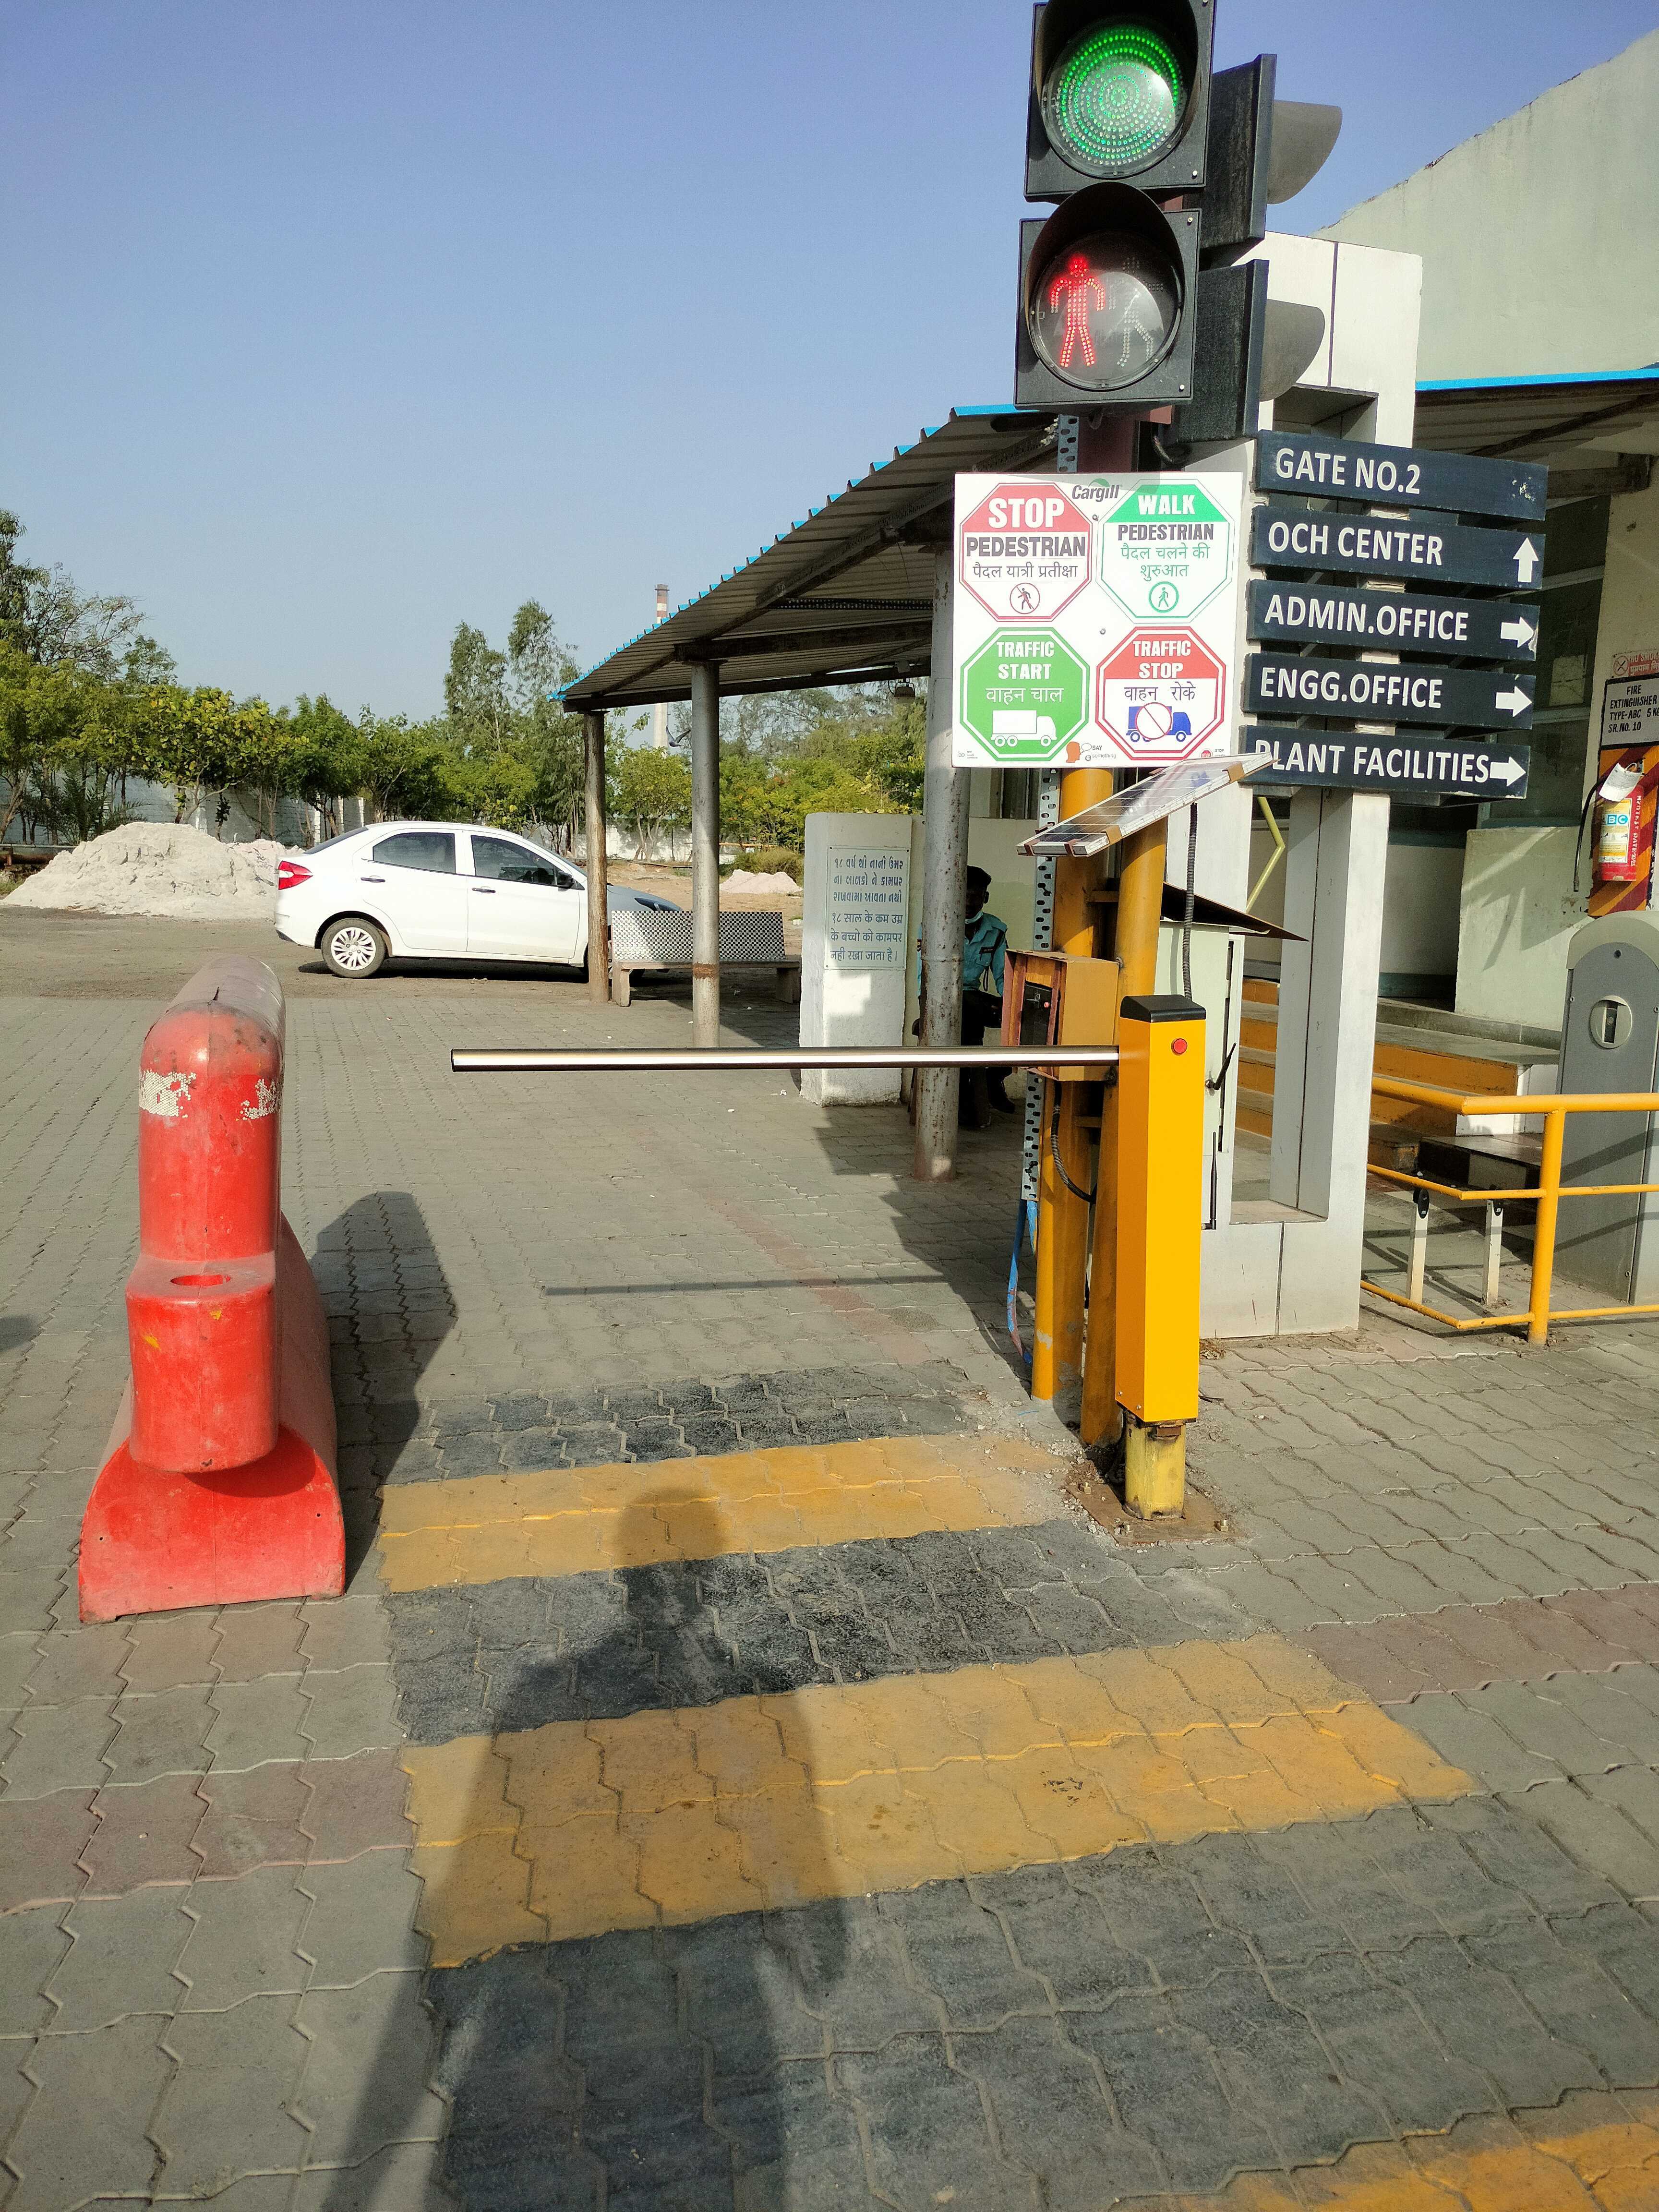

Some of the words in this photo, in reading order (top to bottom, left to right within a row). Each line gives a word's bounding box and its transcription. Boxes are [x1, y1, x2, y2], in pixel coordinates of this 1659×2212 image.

[1275, 447, 1347, 485] GATE
[1356, 458, 1421, 494] NO.2
[1072, 485, 1119, 502] Cargill
[1138, 494, 1195, 515] WALK
[988, 498, 1064, 529] STOP
[1118, 524, 1214, 541] PEDESTRIAN
[966, 536, 1085, 557] PEDESTRIAN
[1120, 542, 1152, 560] पैदल
[1155, 542, 1188, 559] चलने
[1192, 542, 1211, 559] की
[1269, 521, 1328, 555] OCH
[1337, 527, 1443, 565] CENTER
[973, 562, 1002, 577] पैदल
[1006, 562, 1034, 577] यात्री
[1038, 562, 1078, 578] प्रतीक्षा
[1141, 565, 1189, 582] शुरुआत
[1264, 594, 1469, 641] ADMIN.OFFICE
[996, 641, 1055, 657] TRAFFIC
[1133, 640, 1191, 657] TRAFFIC
[998, 663, 1052, 679] START
[1139, 662, 1183, 679] STOP
[985, 688, 1026, 705] वाहन
[1030, 687, 1064, 703] चाल
[1124, 687, 1158, 701] वाहन
[1170, 681, 1196, 701] रोके
[1261, 667, 1443, 709] ENGG.OFFICE
[1627, 685, 1641, 695] FIRE
[1610, 695, 1657, 709] EXTINGUISHER
[1255, 740, 1345, 774] PLANT
[1353, 746, 1490, 783] FACILITIES
[869, 855, 886, 869] નાની
[889, 889, 902, 903] નથી
[844, 914, 862, 923] साल
[865, 910, 873, 923] के
[875, 914, 890, 923] कम
[830, 927, 839, 941] के
[863, 928, 874, 942] को
[847, 951, 863, 961] रखा
[865, 951, 885, 961] जाता
